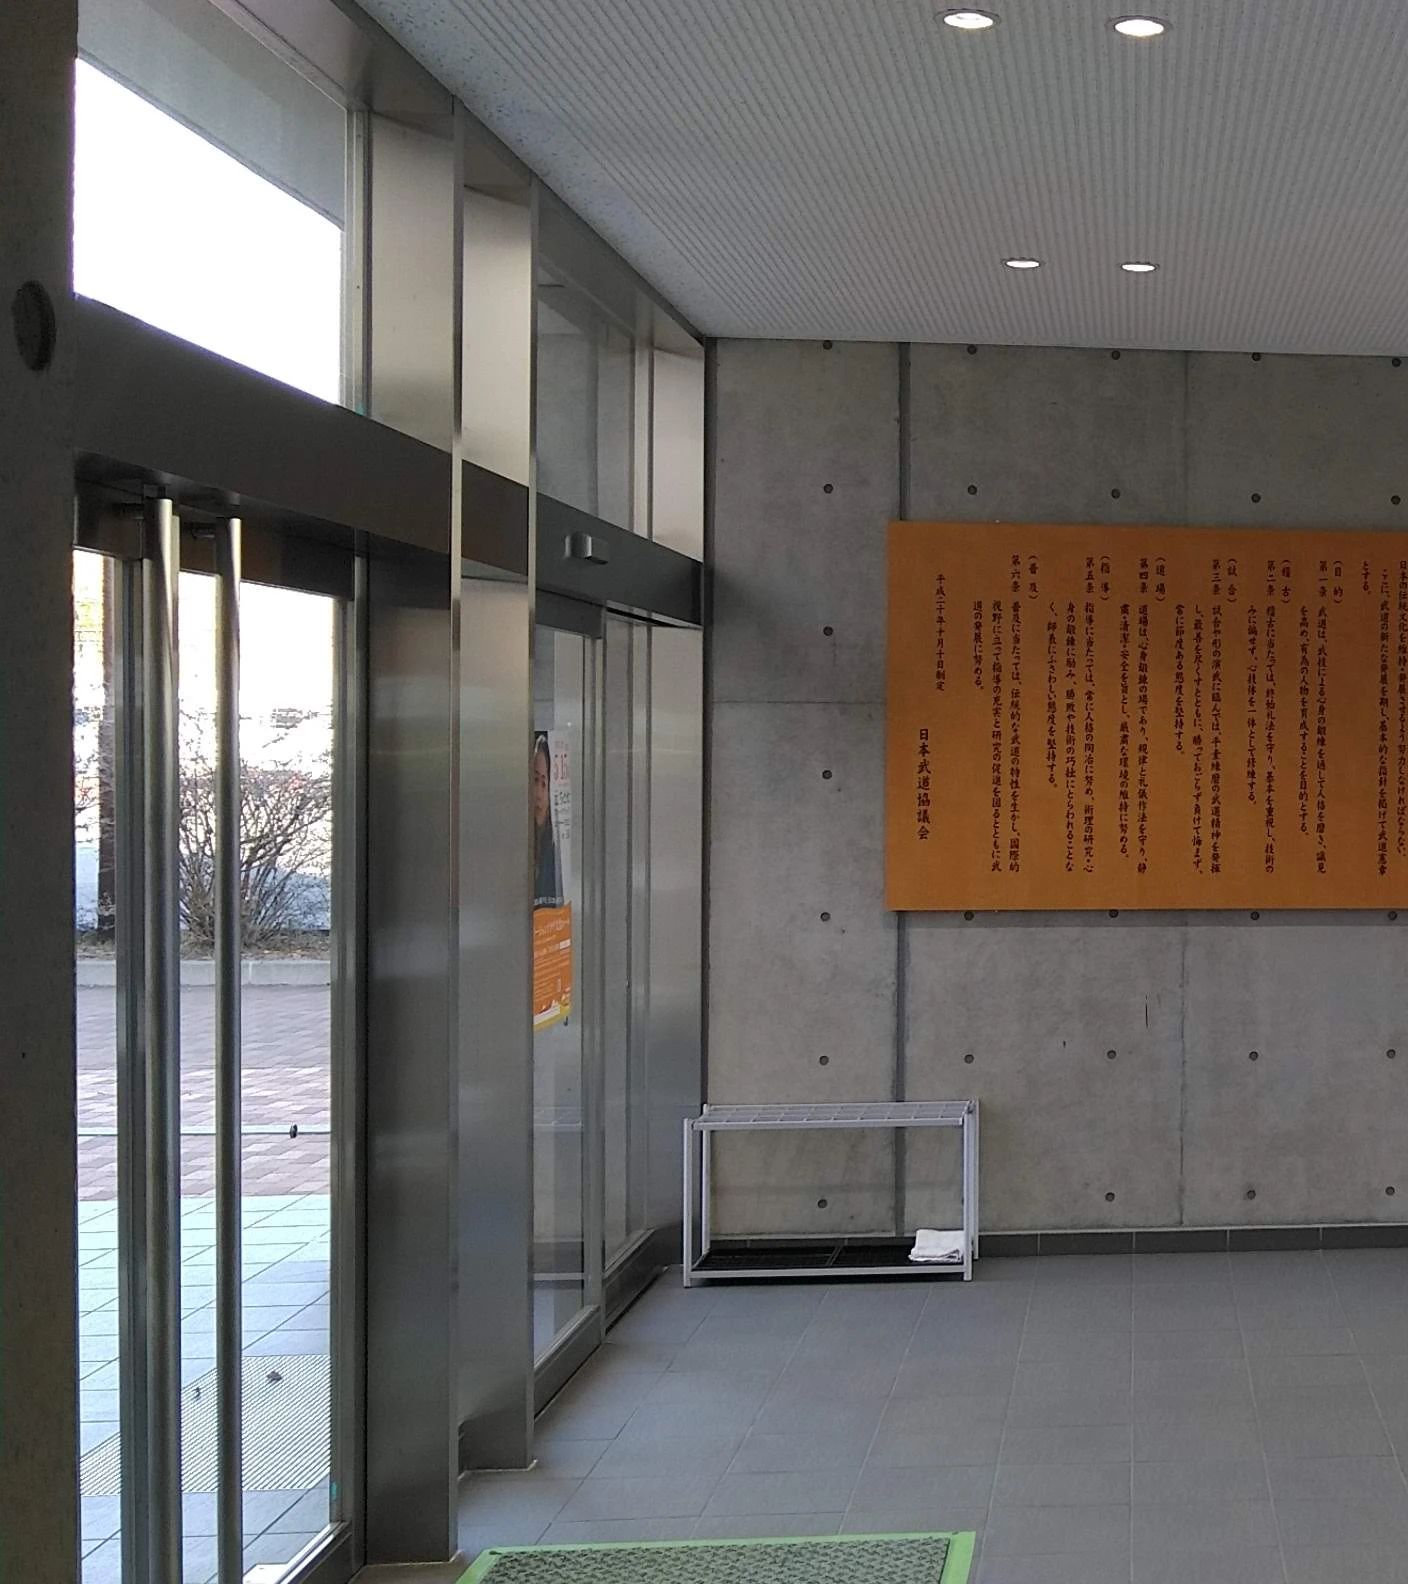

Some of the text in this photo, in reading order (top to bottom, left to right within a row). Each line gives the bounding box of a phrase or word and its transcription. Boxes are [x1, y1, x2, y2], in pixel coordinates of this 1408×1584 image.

[917, 729, 931, 839] 日本武道協議会
